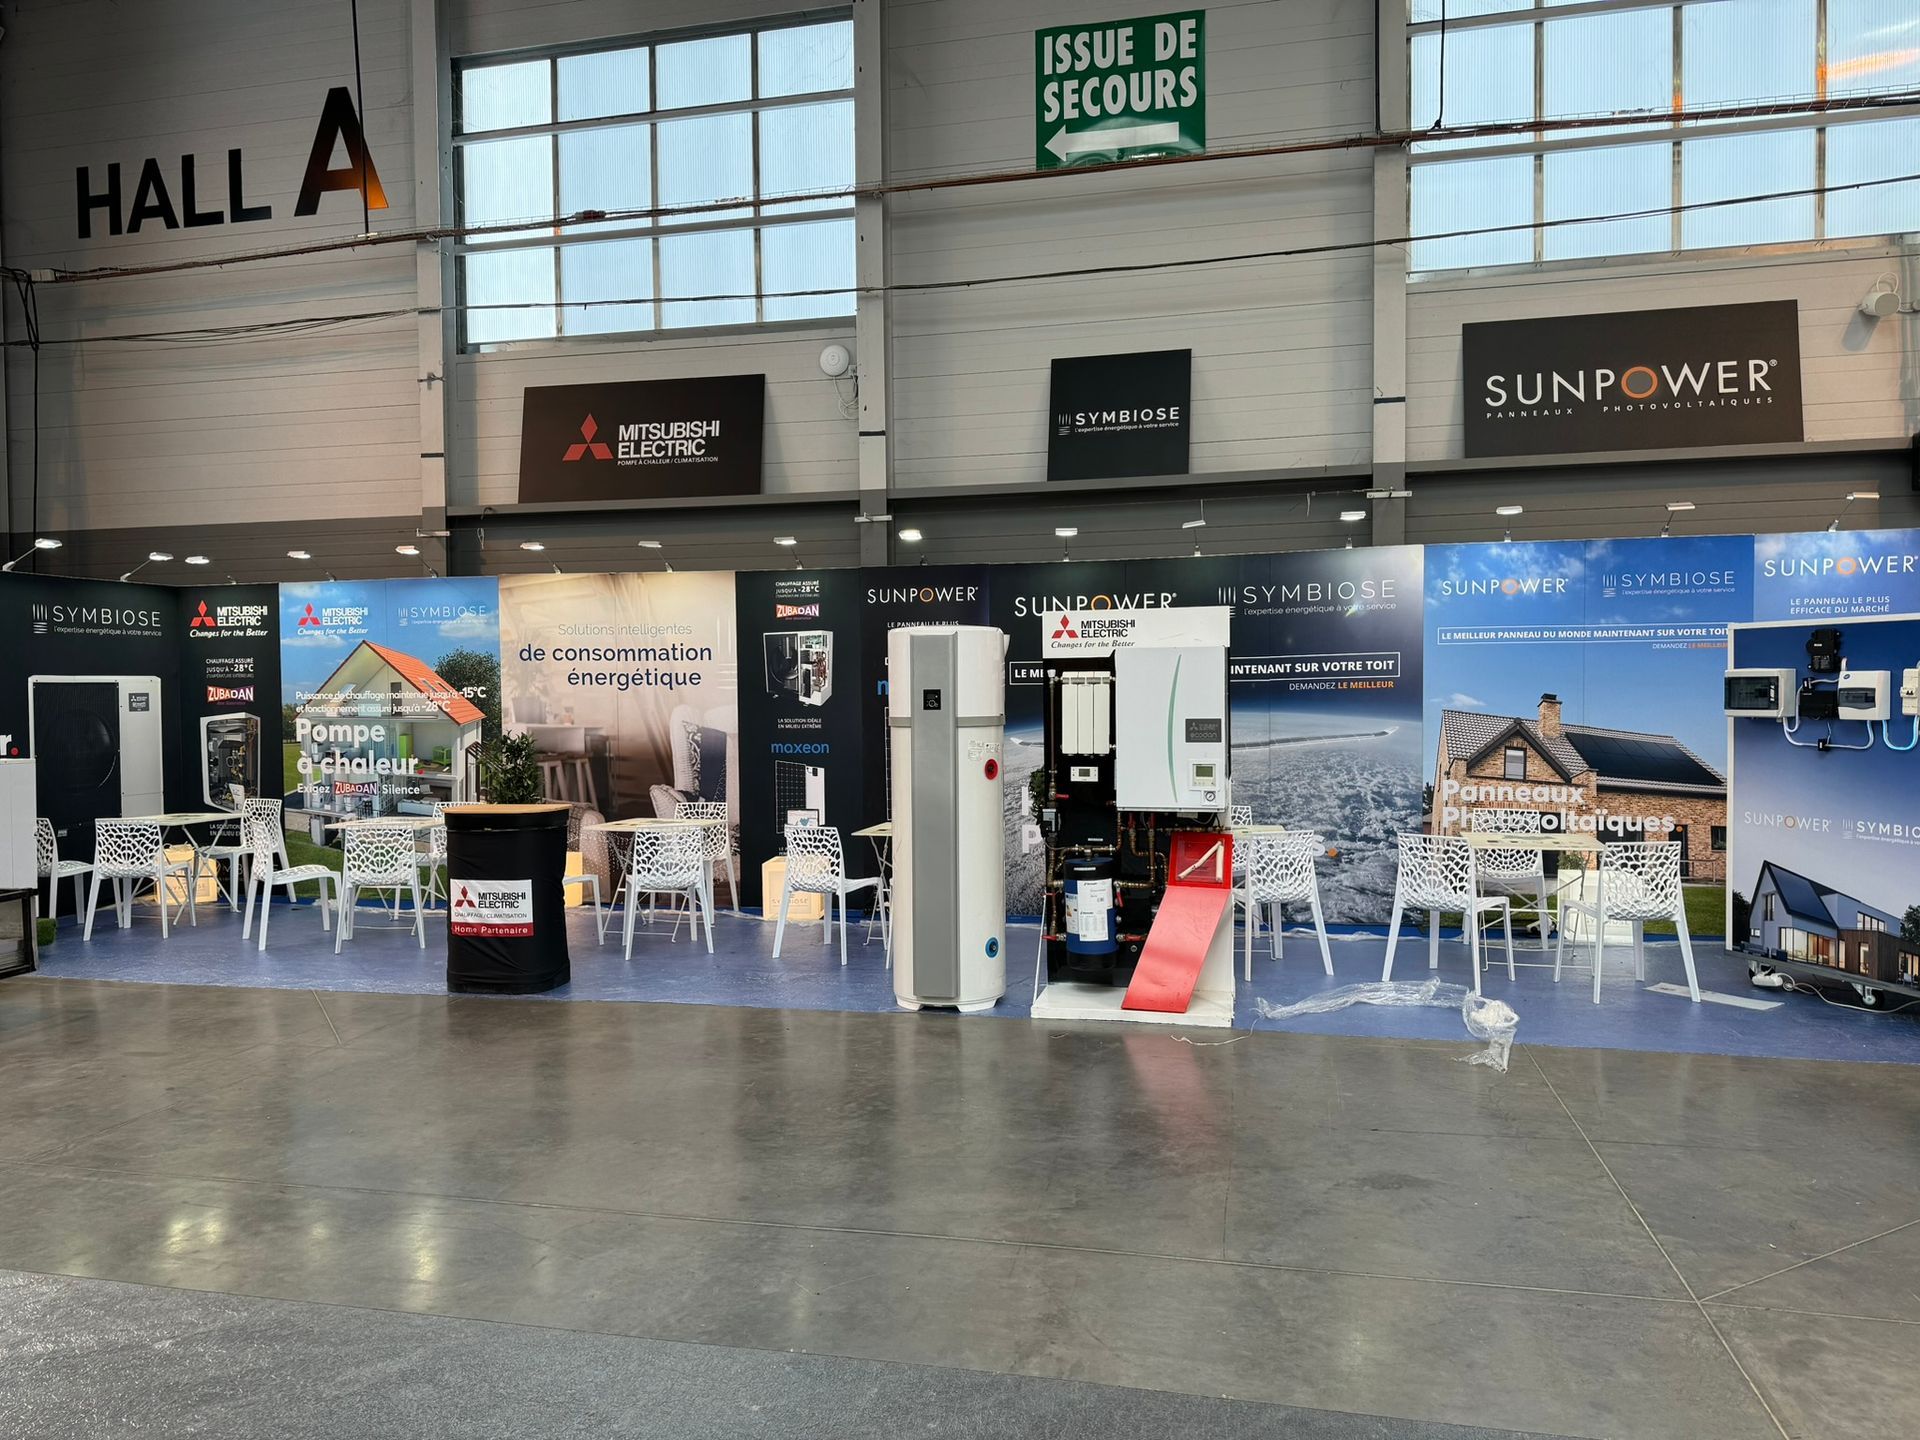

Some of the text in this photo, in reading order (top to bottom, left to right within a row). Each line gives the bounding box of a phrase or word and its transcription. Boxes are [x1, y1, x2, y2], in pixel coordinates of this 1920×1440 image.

[1044, 18, 1197, 76] ISSUE DE
[1044, 66, 1198, 123] SECOURS
[76, 86, 389, 239] HALL A
[1486, 396, 1773, 419] PANNEAUX PHOTOVOLTAÏQUES
[1075, 406, 1180, 426] SYMBIOSE
[618, 420, 720, 441] MITSUBISHI
[618, 439, 706, 459] ELECTRIC
[1622, 571, 1734, 587] SYMBIOSE
[1243, 580, 1396, 604] SYMBIOSE
[217, 606, 268, 616] MITSUBISHI
[322, 607, 368, 617] MITSUBISHI
[410, 606, 486, 618] SYMBIOSE
[1244, 607, 1284, 617] l'expertise
[1285, 605, 1334, 615] énergétique
[1366, 602, 1396, 610] service
[1851, 604, 1890, 612] MARCHÉ
[52, 605, 161, 628] SYMBIOSE
[217, 616, 262, 626] ELECTRIC
[322, 616, 362, 626] ELECTRIC
[558, 622, 692, 638] Solutions intelligentes
[1081, 619, 1136, 629] MITSUBISHI
[86, 626, 122, 636] énergétique
[189, 628, 268, 638] Changes for the Better
[298, 626, 368, 636] Changes for the Better
[1081, 628, 1128, 638] ELECTRIC
[1454, 631, 1496, 640] MEILLEUR
[1498, 631, 1540, 639] PANNEAU
[1558, 630, 1592, 638] MONDE
[1594, 629, 1654, 638] MAINTENANT
[1051, 641, 1082, 650] Changes
[1084, 640, 1096, 649] for
[519, 643, 712, 662] de consommation
[1295, 663, 1319, 674] SUR
[1322, 661, 1362, 672] VOTRE
[1366, 660, 1394, 671] TOIT
[567, 668, 702, 690] énergétique
[1015, 669, 1027, 678] LE
[1289, 682, 1336, 691] DEMANDEZ
[296, 692, 332, 700] Puissance
[345, 691, 385, 702] chauffage
[386, 691, 428, 700] maintenue
[459, 686, 487, 698] -15°C
[305, 704, 365, 712] fonctionnement
[366, 704, 391, 712] assuré
[422, 700, 450, 712] -28°C
[296, 718, 386, 747] Pompe
[771, 742, 830, 754] maxeon
[296, 751, 312, 774] à
[297, 783, 330, 794] Exigez
[382, 784, 420, 794] Silence
[1442, 780, 1585, 803] Panneaux
[478, 892, 526, 900] MITSUBISHI
[478, 901, 520, 909] ELECTRIC
